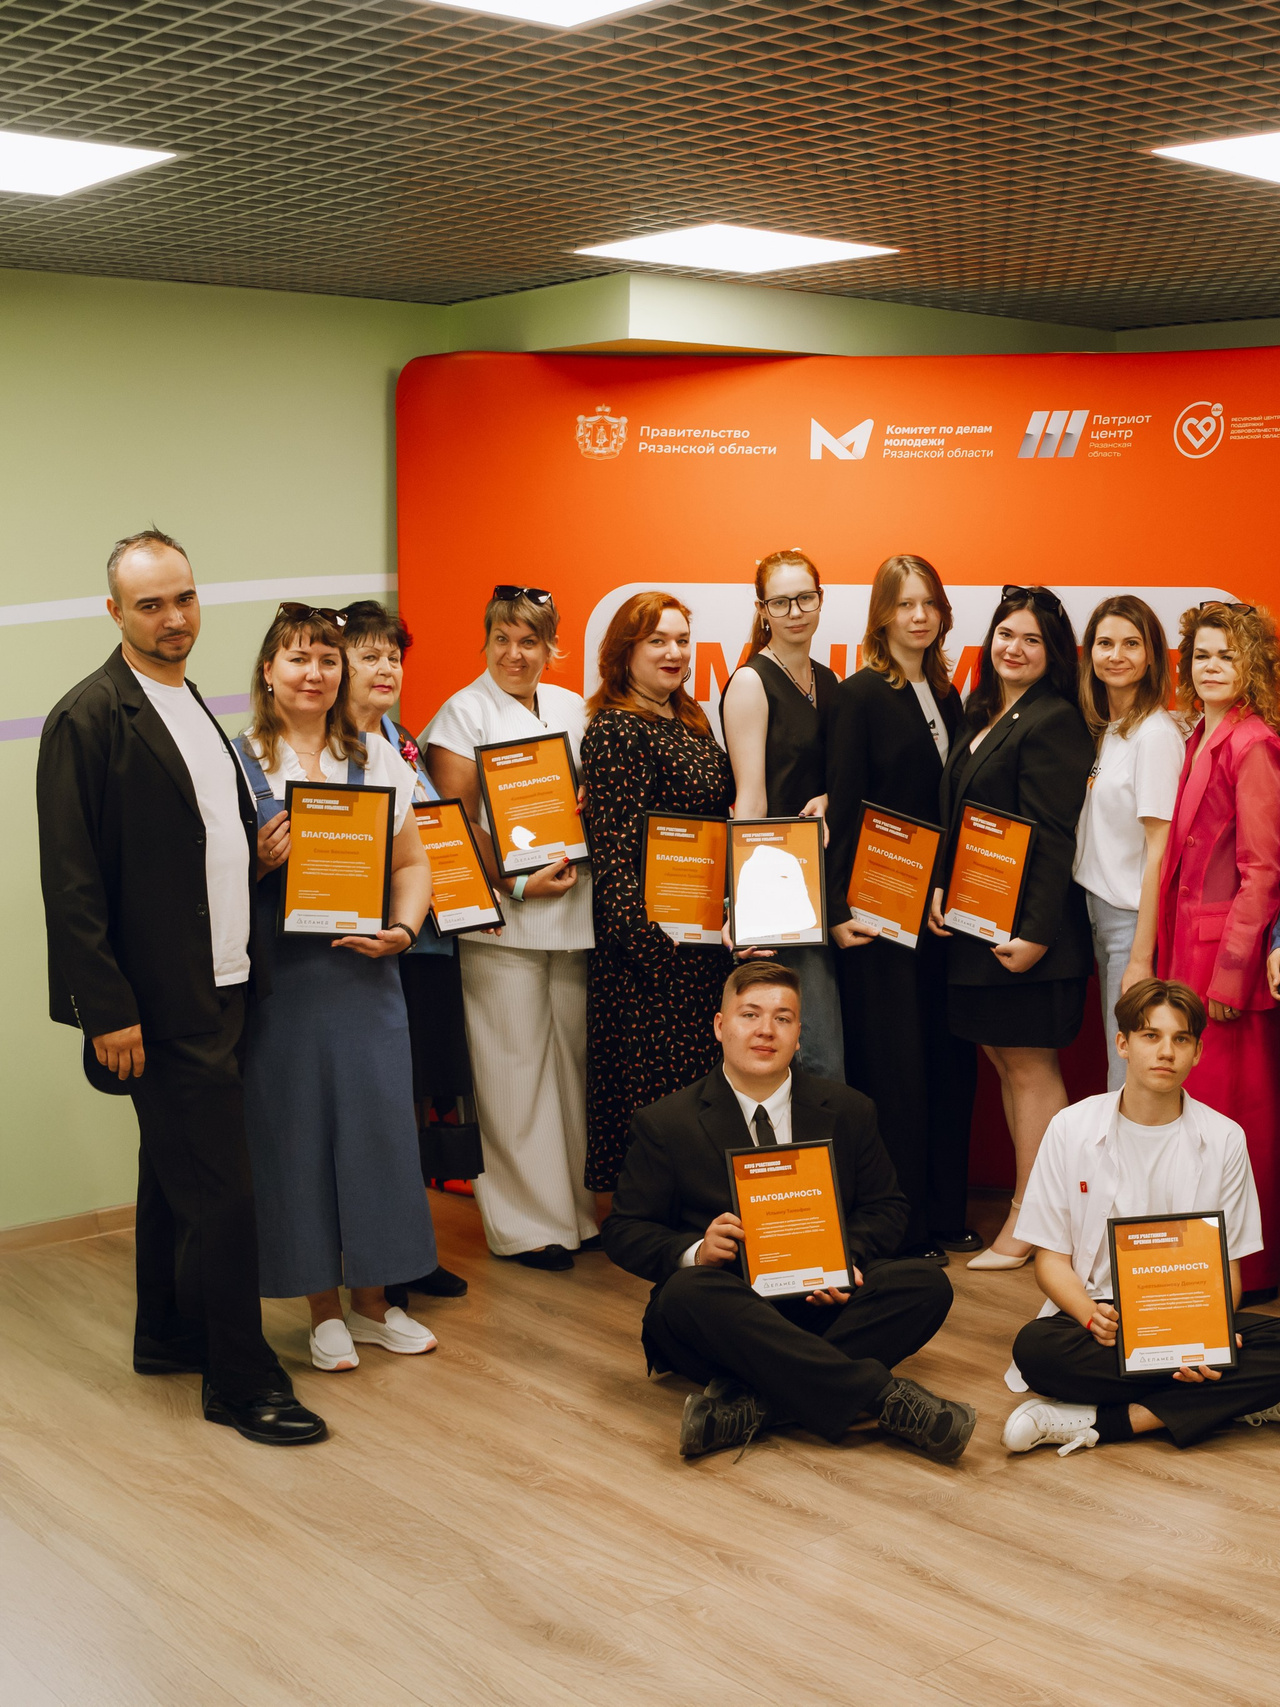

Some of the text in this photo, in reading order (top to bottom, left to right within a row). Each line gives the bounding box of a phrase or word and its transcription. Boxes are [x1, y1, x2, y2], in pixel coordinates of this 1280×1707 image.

[1092, 413, 1152, 425] Патриот
[639, 425, 751, 440] Правительство
[885, 424, 993, 436] Комитет по делам
[1090, 428, 1133, 440] центр
[883, 436, 946, 448] молодежи
[1089, 441, 1132, 450] Рязанская
[638, 441, 777, 456] Рязанской области
[882, 447, 994, 459] Рязанской области
[1088, 450, 1122, 458] область
[498, 774, 560, 791] БЛАГОДАРНОСТЬ
[301, 830, 374, 841] БЛАГОДАРНОСТЬ
[423, 839, 464, 850] АГОДАРНОСТЬ
[656, 853, 715, 865] БЛАГОДАРНОСТЬ
[867, 844, 924, 870] БЛАГОДАРНОСТЬ
[965, 843, 1017, 866] БЛАГОДАРНОСТЬ
[750, 1188, 823, 1203] БЛАГОДАРНОСТЬ
[1132, 1261, 1210, 1276] БЛАГОДАРНОСТЬ
